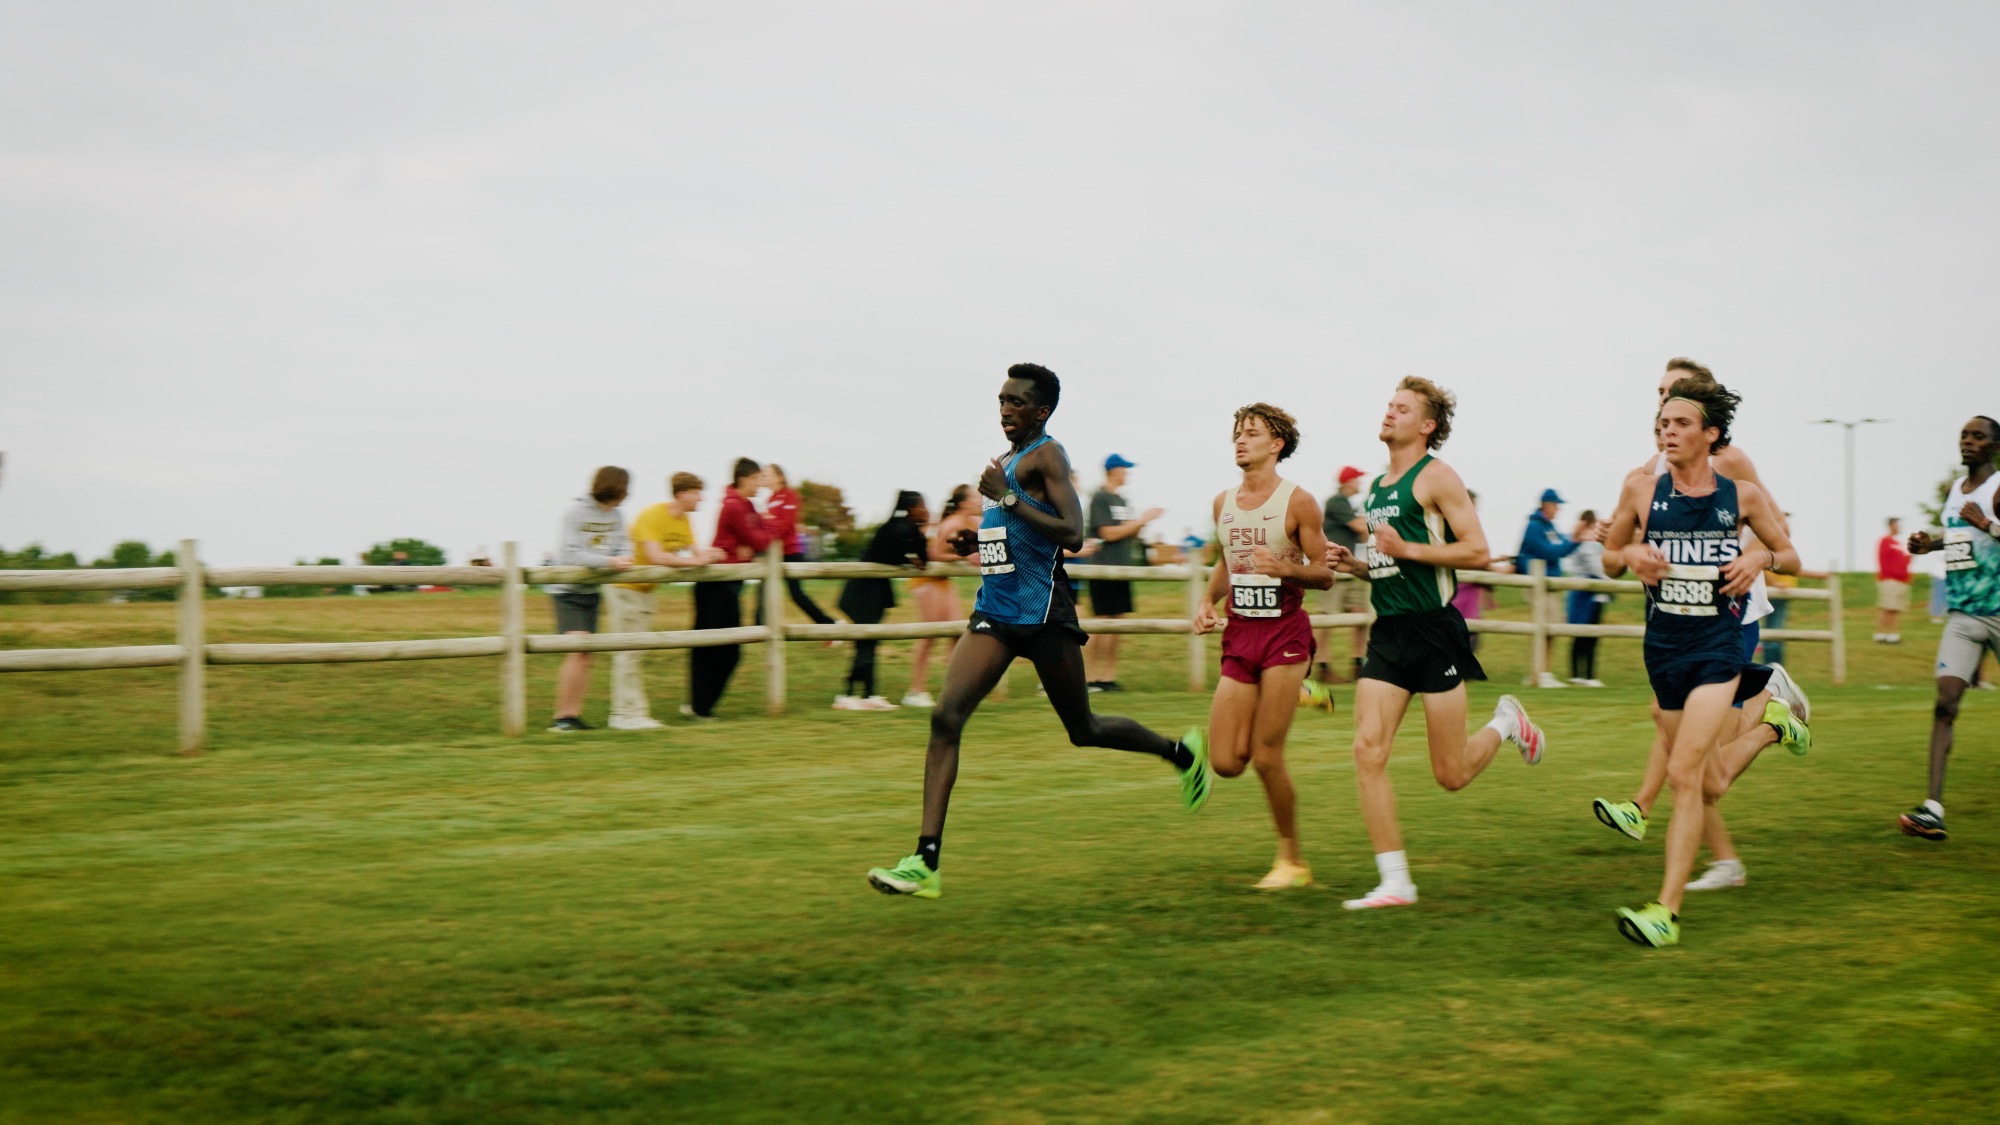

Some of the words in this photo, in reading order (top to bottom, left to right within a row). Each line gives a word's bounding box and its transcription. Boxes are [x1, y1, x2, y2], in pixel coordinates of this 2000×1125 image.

[1229, 528, 1266, 547] FSU
[1693, 530, 1725, 539] SCHOOL
[1648, 539, 1739, 563] MINES
[1234, 587, 1277, 607] 5615
[1660, 579, 1714, 605] 5538
